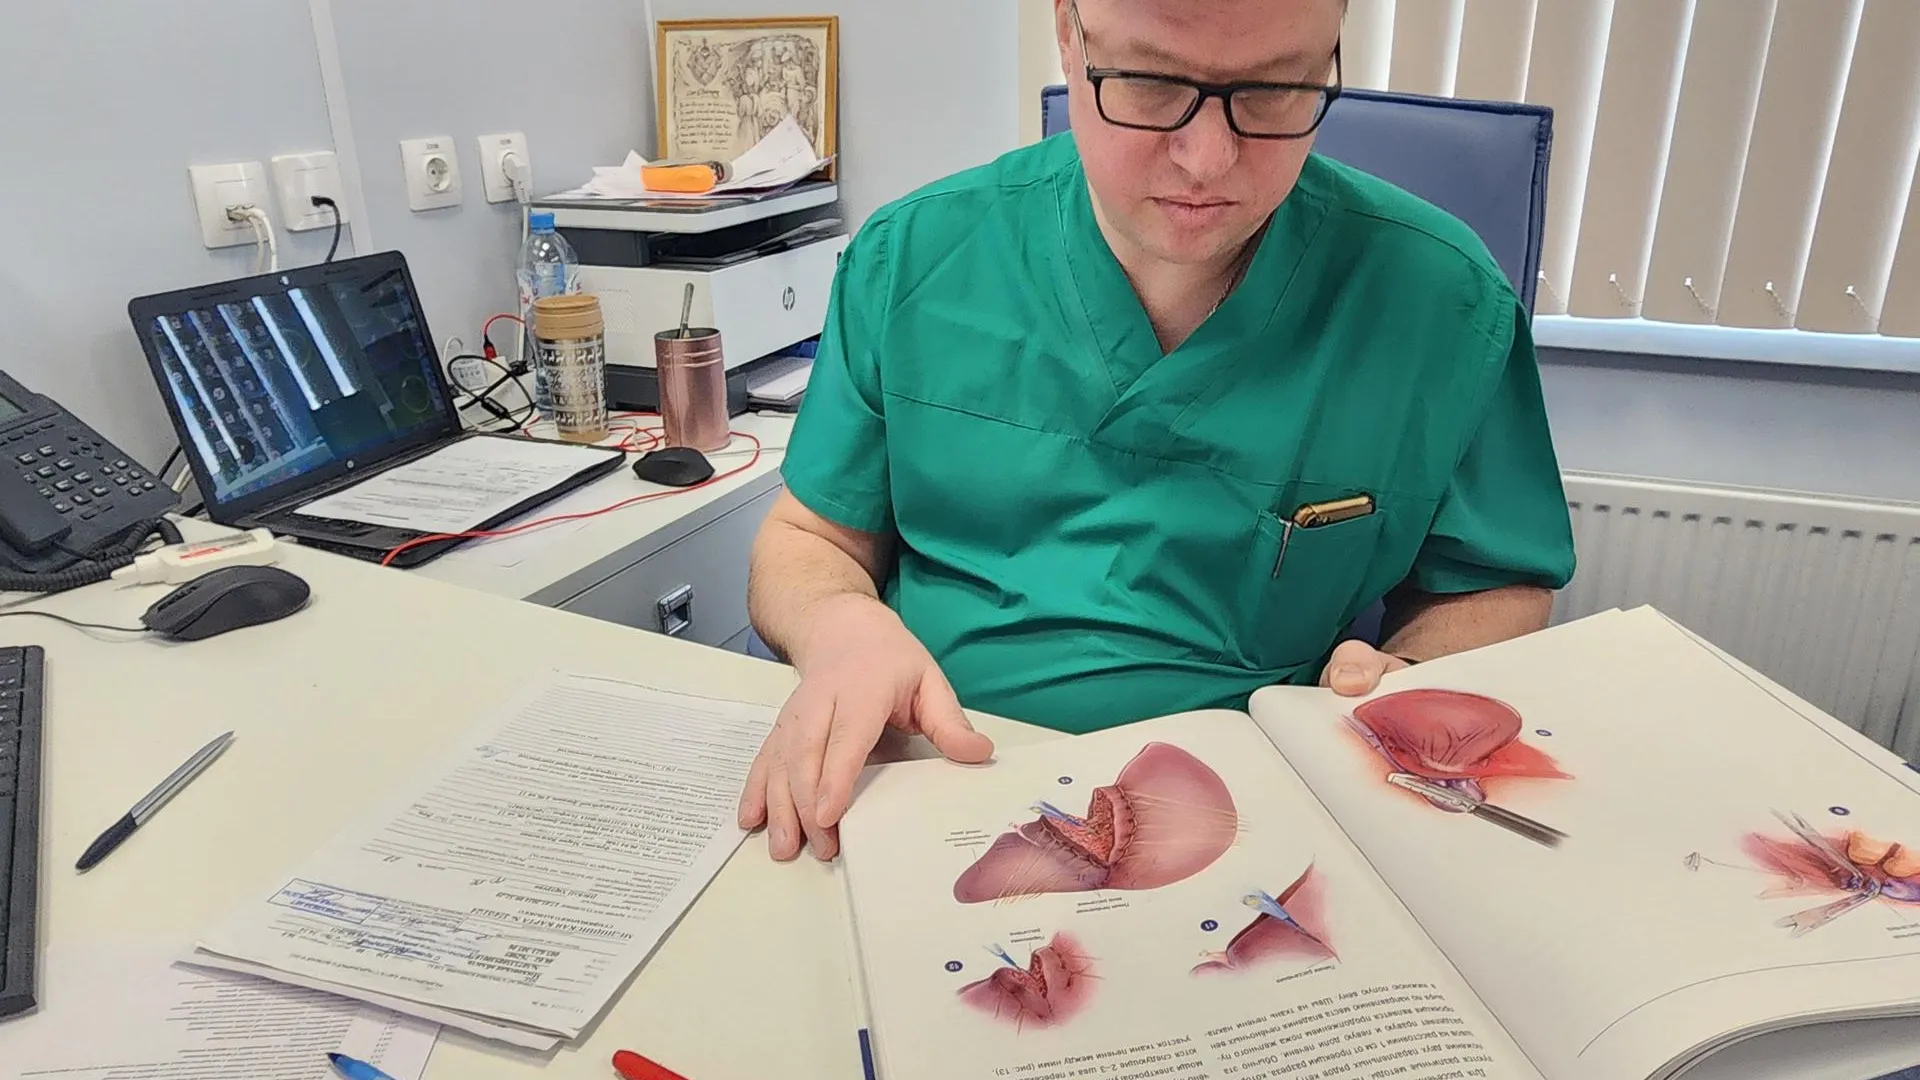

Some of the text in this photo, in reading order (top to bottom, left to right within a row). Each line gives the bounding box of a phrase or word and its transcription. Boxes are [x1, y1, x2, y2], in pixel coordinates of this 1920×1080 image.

[783, 286, 795, 311] hp
[1360, 985, 1389, 994] полую
[1311, 996, 1334, 1008] Швы
[1352, 996, 1410, 1010] направлению
[1269, 1007, 1294, 1018] ткань
[1324, 1005, 1351, 1017] места
[1373, 1007, 1412, 1019] является
[1235, 1015, 1267, 1028] печени
[1281, 1013, 1324, 1029] впадения
[1304, 1013, 1372, 1037] продолжением
[1384, 1020, 1418, 1031] правую
[1204, 1025, 1233, 1037] накла-
[1343, 1029, 1372, 1041] левую
[1279, 1032, 1302, 1044] ложа
[1318, 1036, 1341, 1048] доли
[1386, 1031, 1438, 1046] расстоянии
[1210, 1041, 1226, 1050] вен
[1233, 1040, 1276, 1057] желчного
[1353, 1046, 1364, 1054] от
[1365, 1042, 1378, 1051] см
[1420, 1043, 1442, 1053] двух
[992, 1035, 1191, 1077] участок ткани печени между ними (рис. 13).
[1174, 1048, 1196, 1058] ются
[1216, 1051, 1231, 1062] пу-
[1308, 1048, 1352, 1066] проекции
[1353, 1049, 1419, 1069] параллельных
[1119, 1054, 1172, 1069] следующие
[1176, 1061, 1203, 1072] мощи
[1241, 1054, 1278, 1070] Обычно
[1410, 1056, 1459, 1071] различные
[1078, 1067, 1096, 1076] шва
[1223, 1065, 1238, 1075] эта
[1322, 1062, 1351, 1078] рядов
[1467, 1068, 1486, 1078] Для
